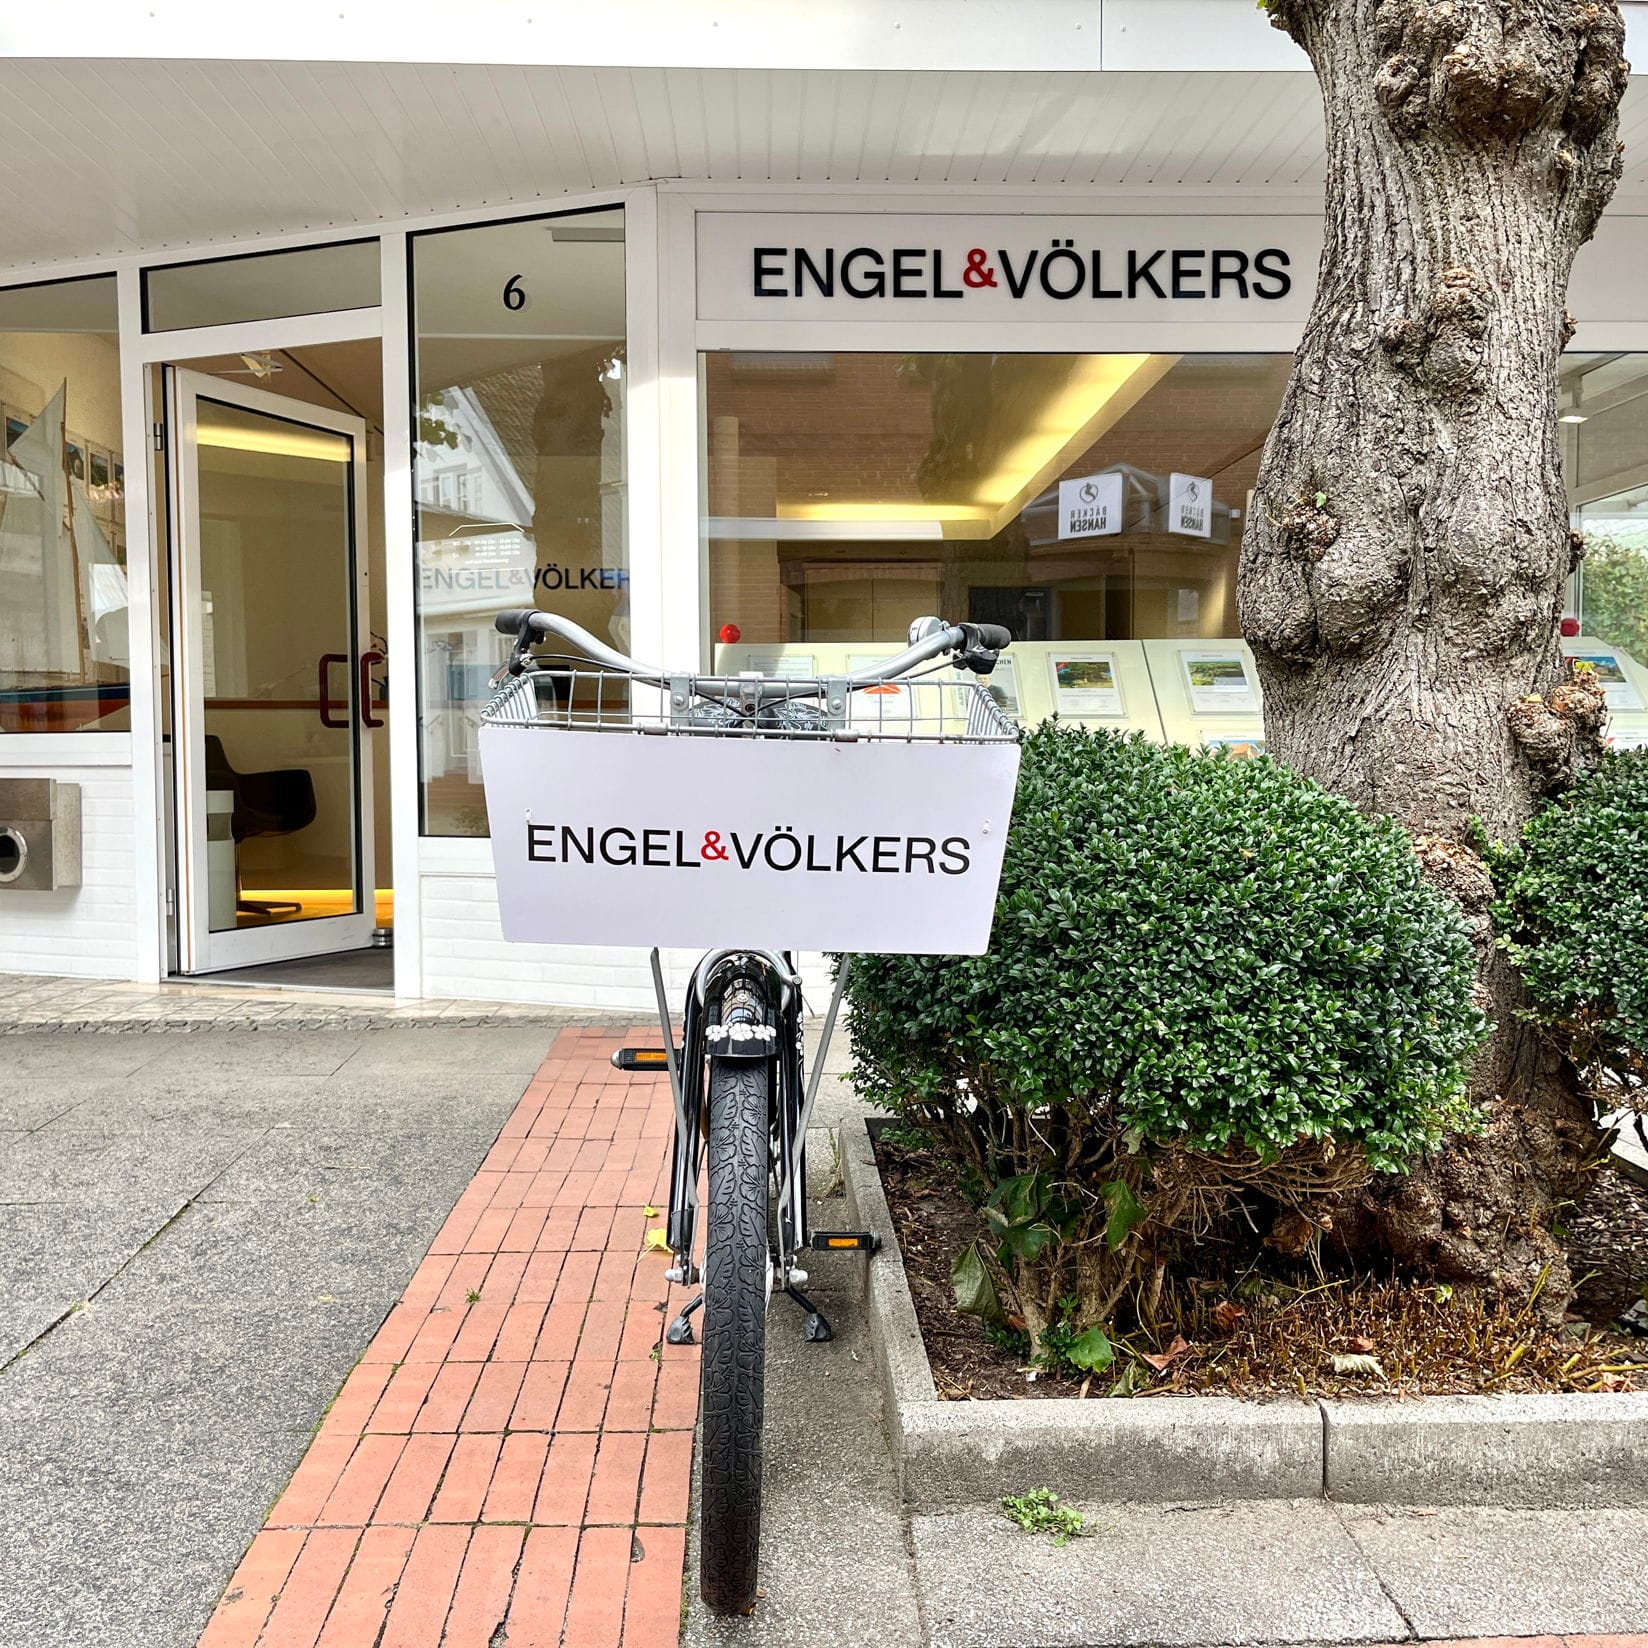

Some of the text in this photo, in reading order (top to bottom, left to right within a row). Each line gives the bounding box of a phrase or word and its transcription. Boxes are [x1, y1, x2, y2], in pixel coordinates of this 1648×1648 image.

[503, 273, 526, 311] 6
[753, 239, 1292, 300] ENGEL&VÖLKERS
[527, 823, 971, 875] ENGEL&VÖLKERS
